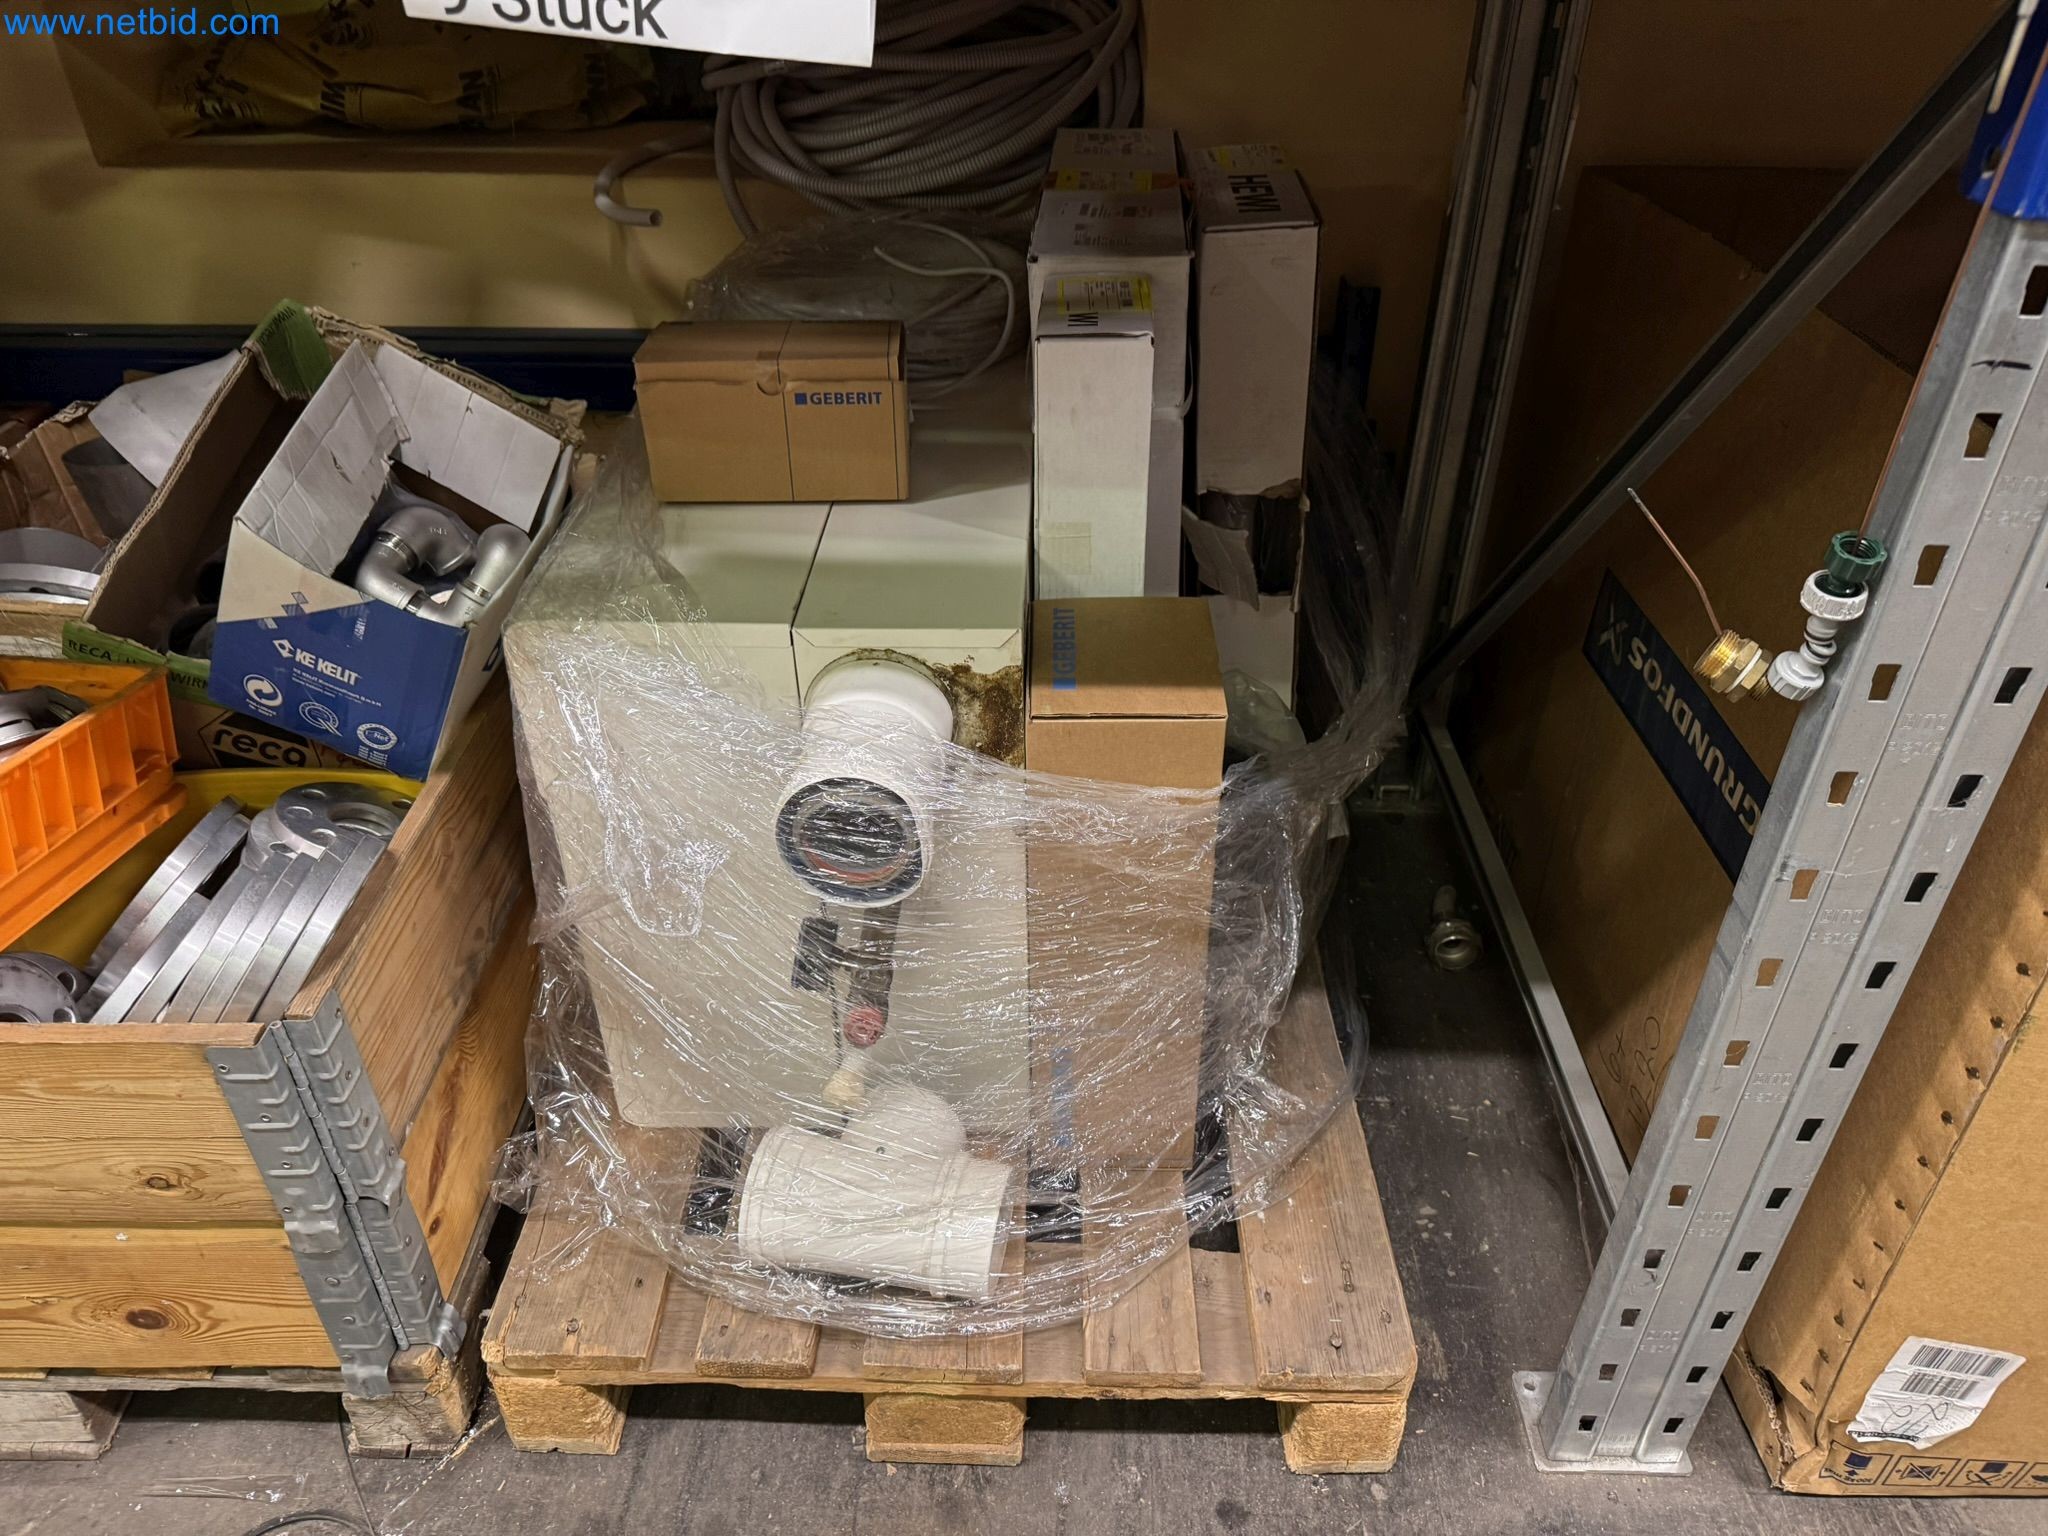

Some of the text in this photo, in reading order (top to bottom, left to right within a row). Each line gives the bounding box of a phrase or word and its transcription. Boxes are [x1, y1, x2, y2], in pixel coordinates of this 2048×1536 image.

[1228, 174, 1281, 213] HEWI
[808, 390, 883, 407] GEBERIT
[68, 639, 112, 662] RECA
[1053, 608, 1075, 674] GEBERIT
[295, 648, 359, 686] KE KELIT
[213, 728, 306, 768] reca
[1628, 636, 1761, 836] GRUNDFOS
